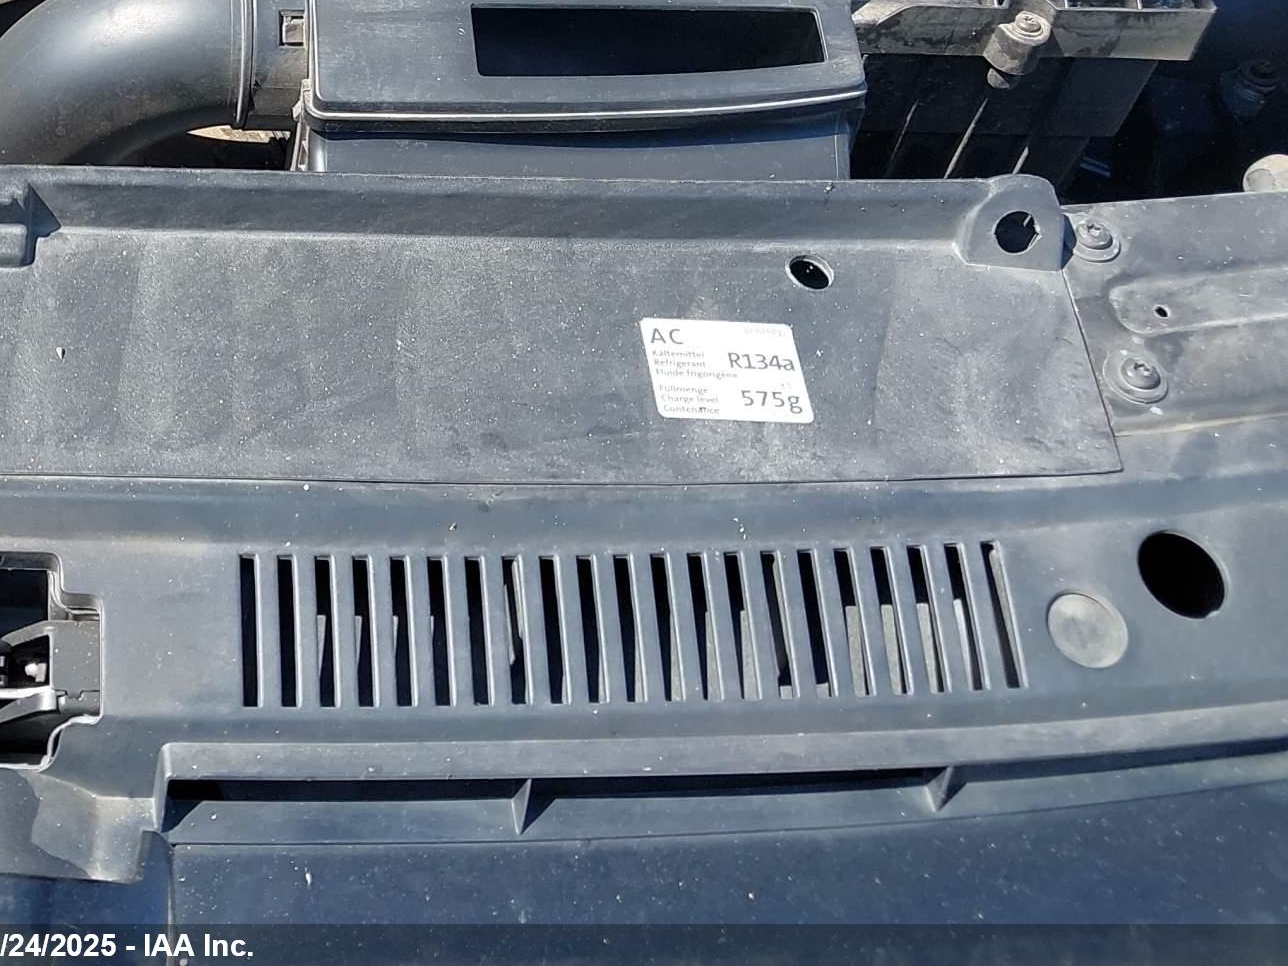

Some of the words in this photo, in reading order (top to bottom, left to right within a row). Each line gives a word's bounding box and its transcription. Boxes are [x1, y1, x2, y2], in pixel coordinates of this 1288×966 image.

[651, 328, 684, 345] AC
[728, 352, 795, 371] R134a
[741, 389, 804, 415] 575g
